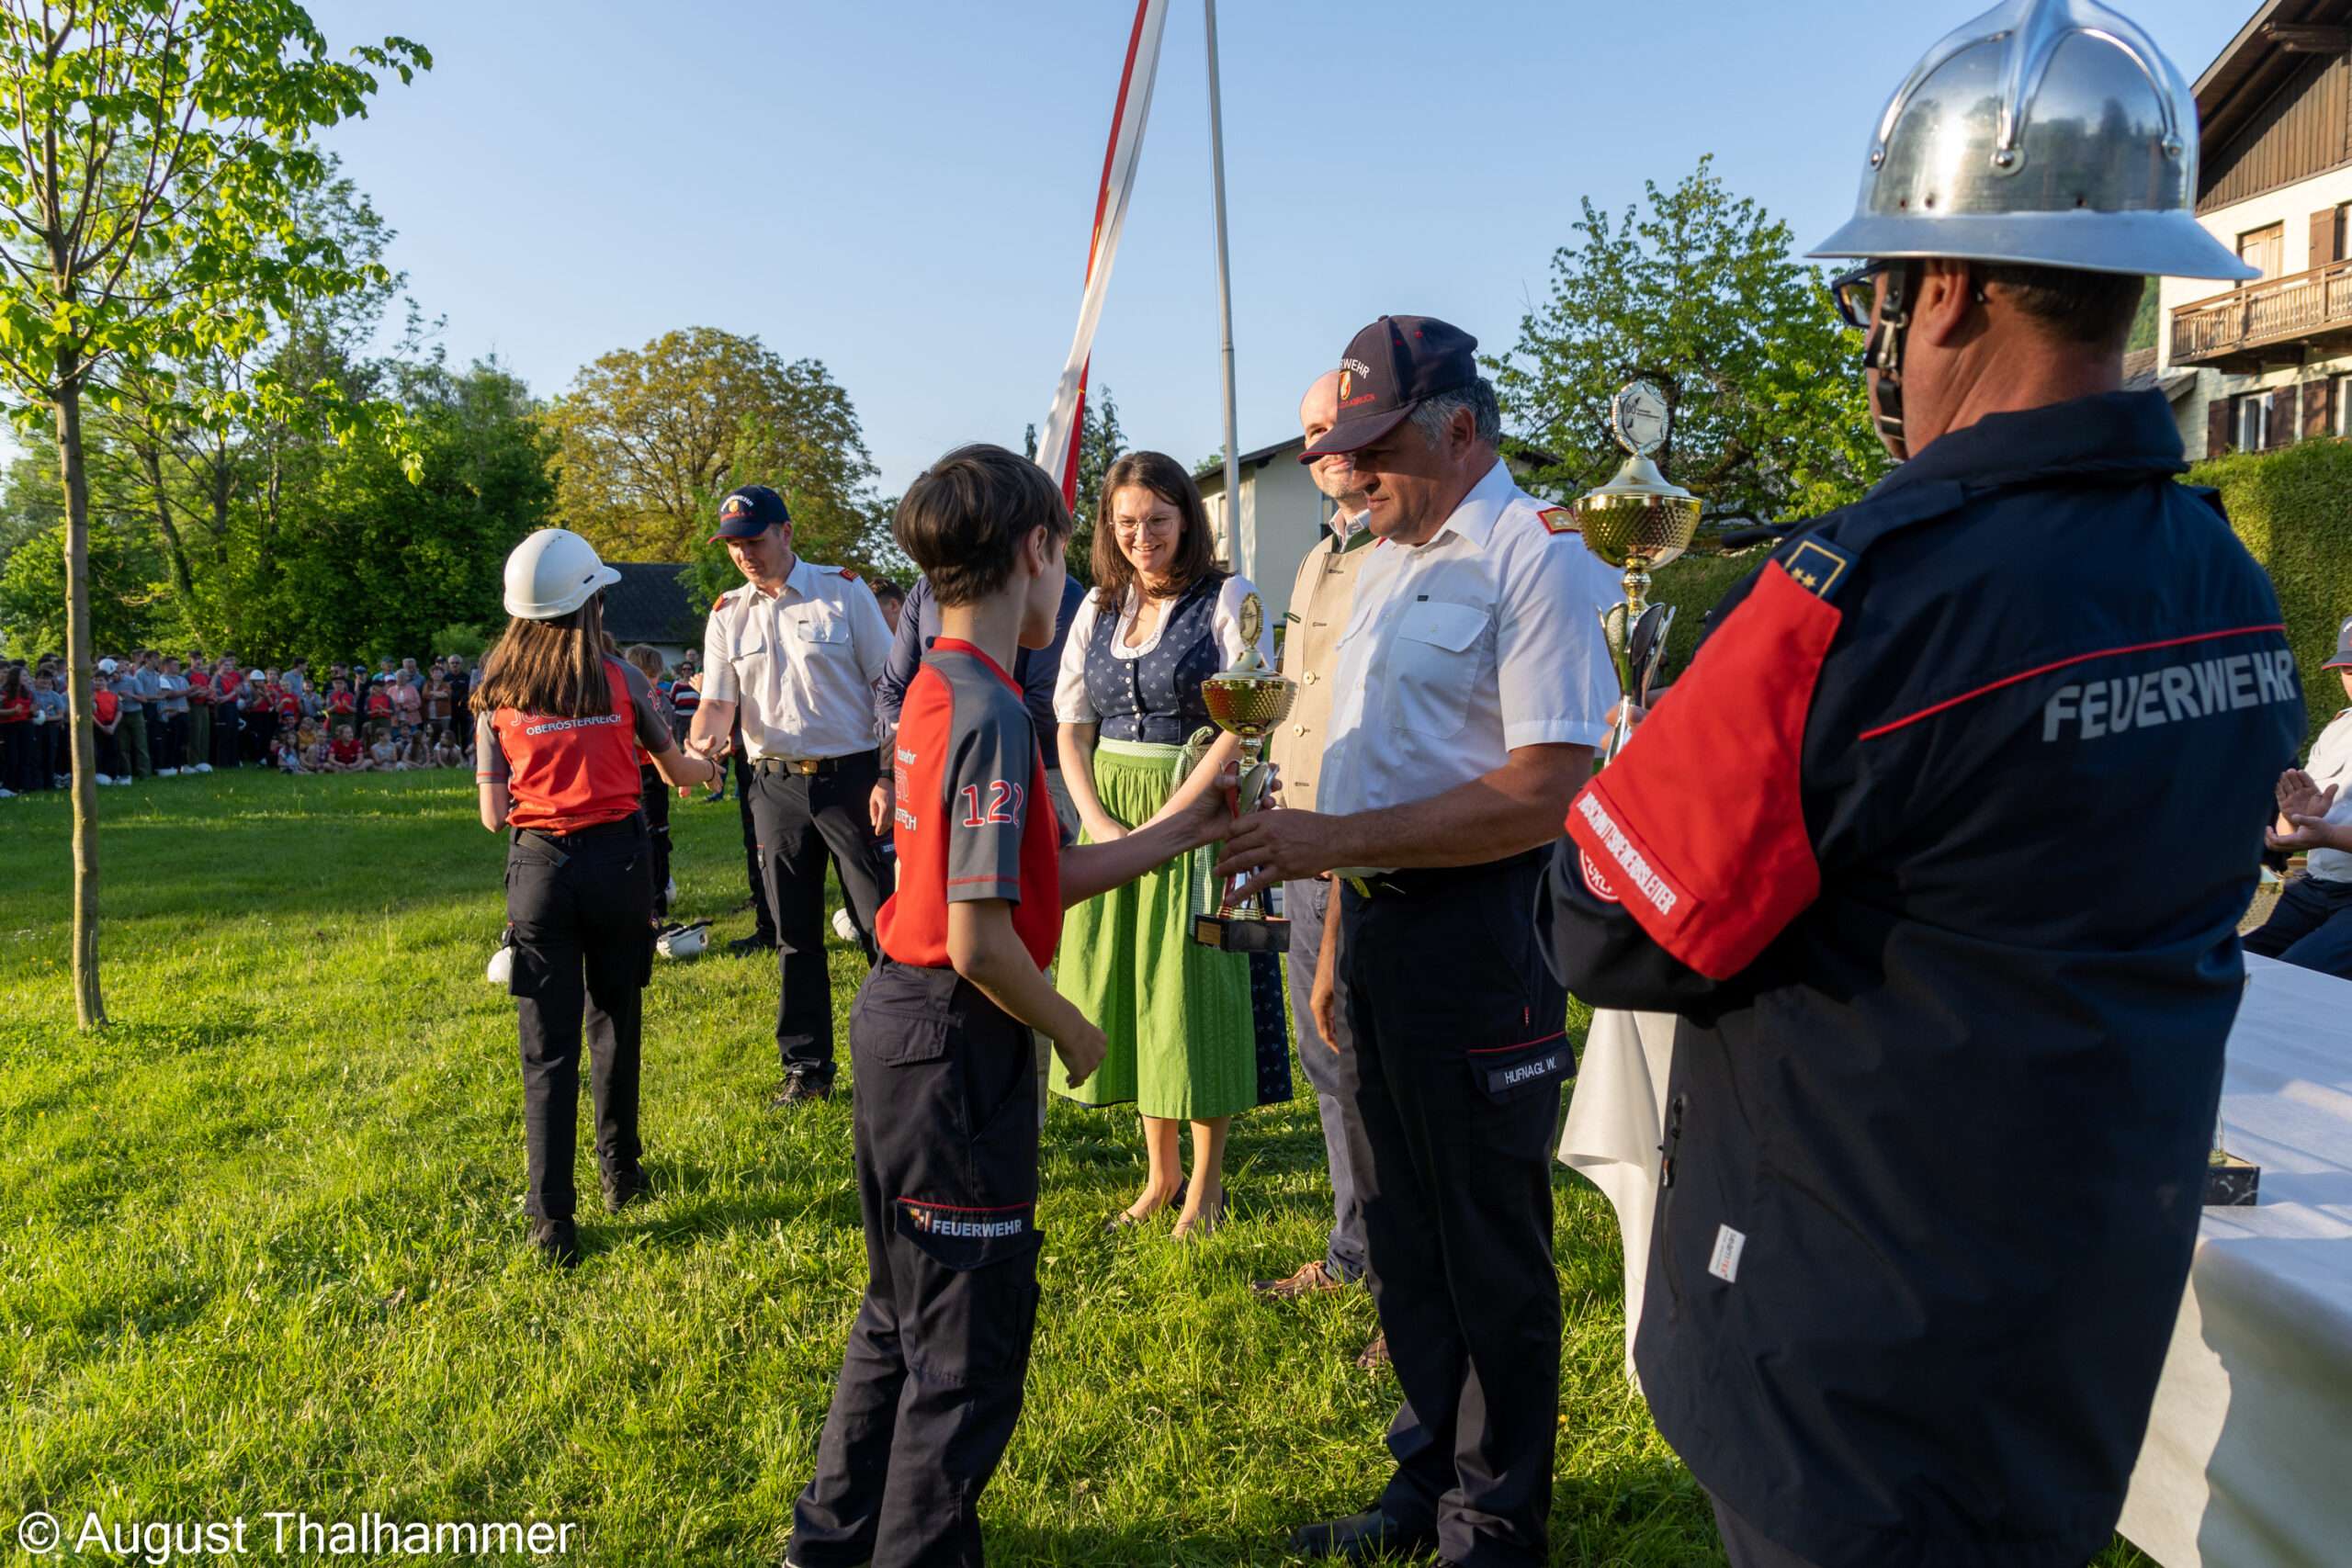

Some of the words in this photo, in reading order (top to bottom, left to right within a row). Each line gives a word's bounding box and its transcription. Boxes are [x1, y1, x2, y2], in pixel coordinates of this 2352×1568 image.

[2042, 649, 2296, 742] FEUERWEHR
[526, 713, 622, 736] OBERÖSTERREICH
[1504, 1061, 1545, 1085] HUFNAGL
[932, 1219, 1023, 1237] FEUERWEHR
